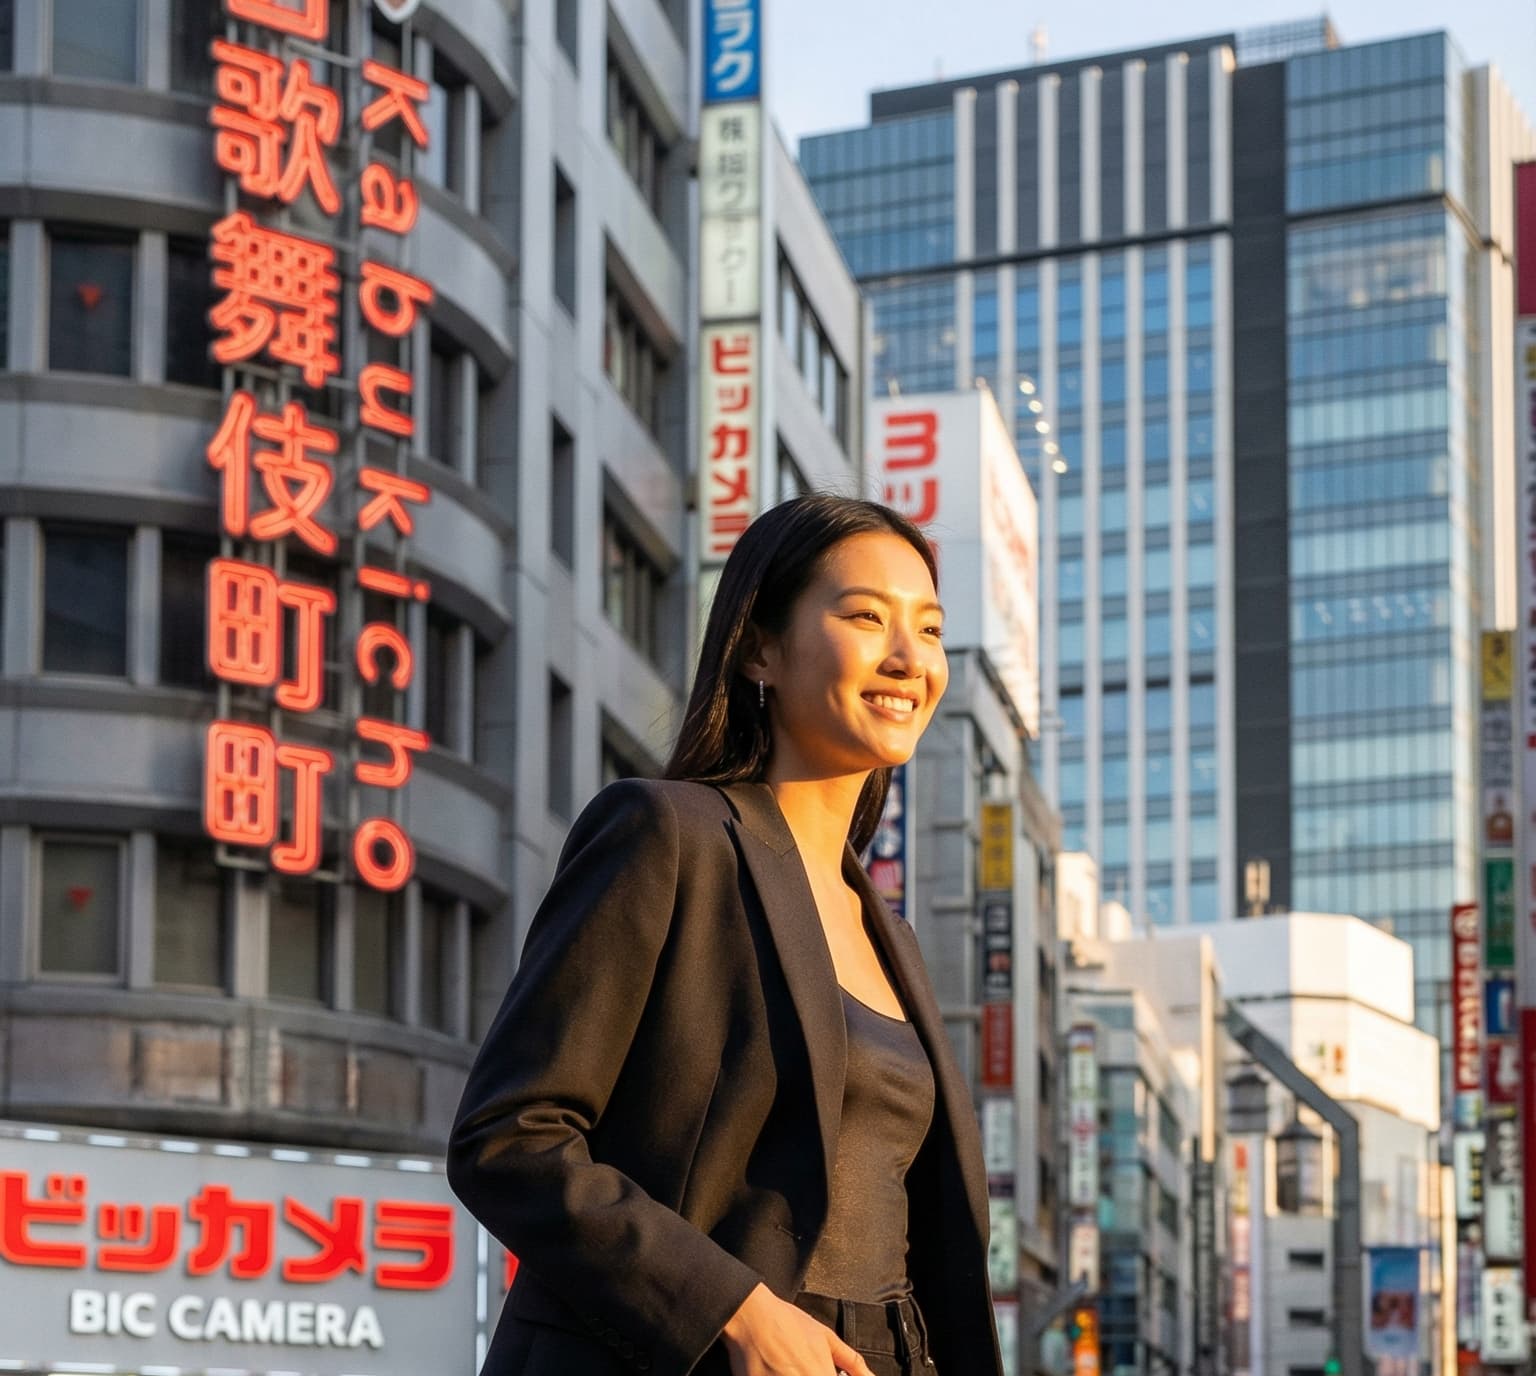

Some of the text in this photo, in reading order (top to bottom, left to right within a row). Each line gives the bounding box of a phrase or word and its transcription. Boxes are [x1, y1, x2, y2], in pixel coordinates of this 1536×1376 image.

[205, 0, 341, 874] 歌舞伎町町
[353, 60, 433, 892] Kabukicho
[711, 336, 751, 553] ビッカメラ
[0, 1169, 456, 1290] ビッカメラ
[71, 1289, 384, 1348] BIC CAMERA
